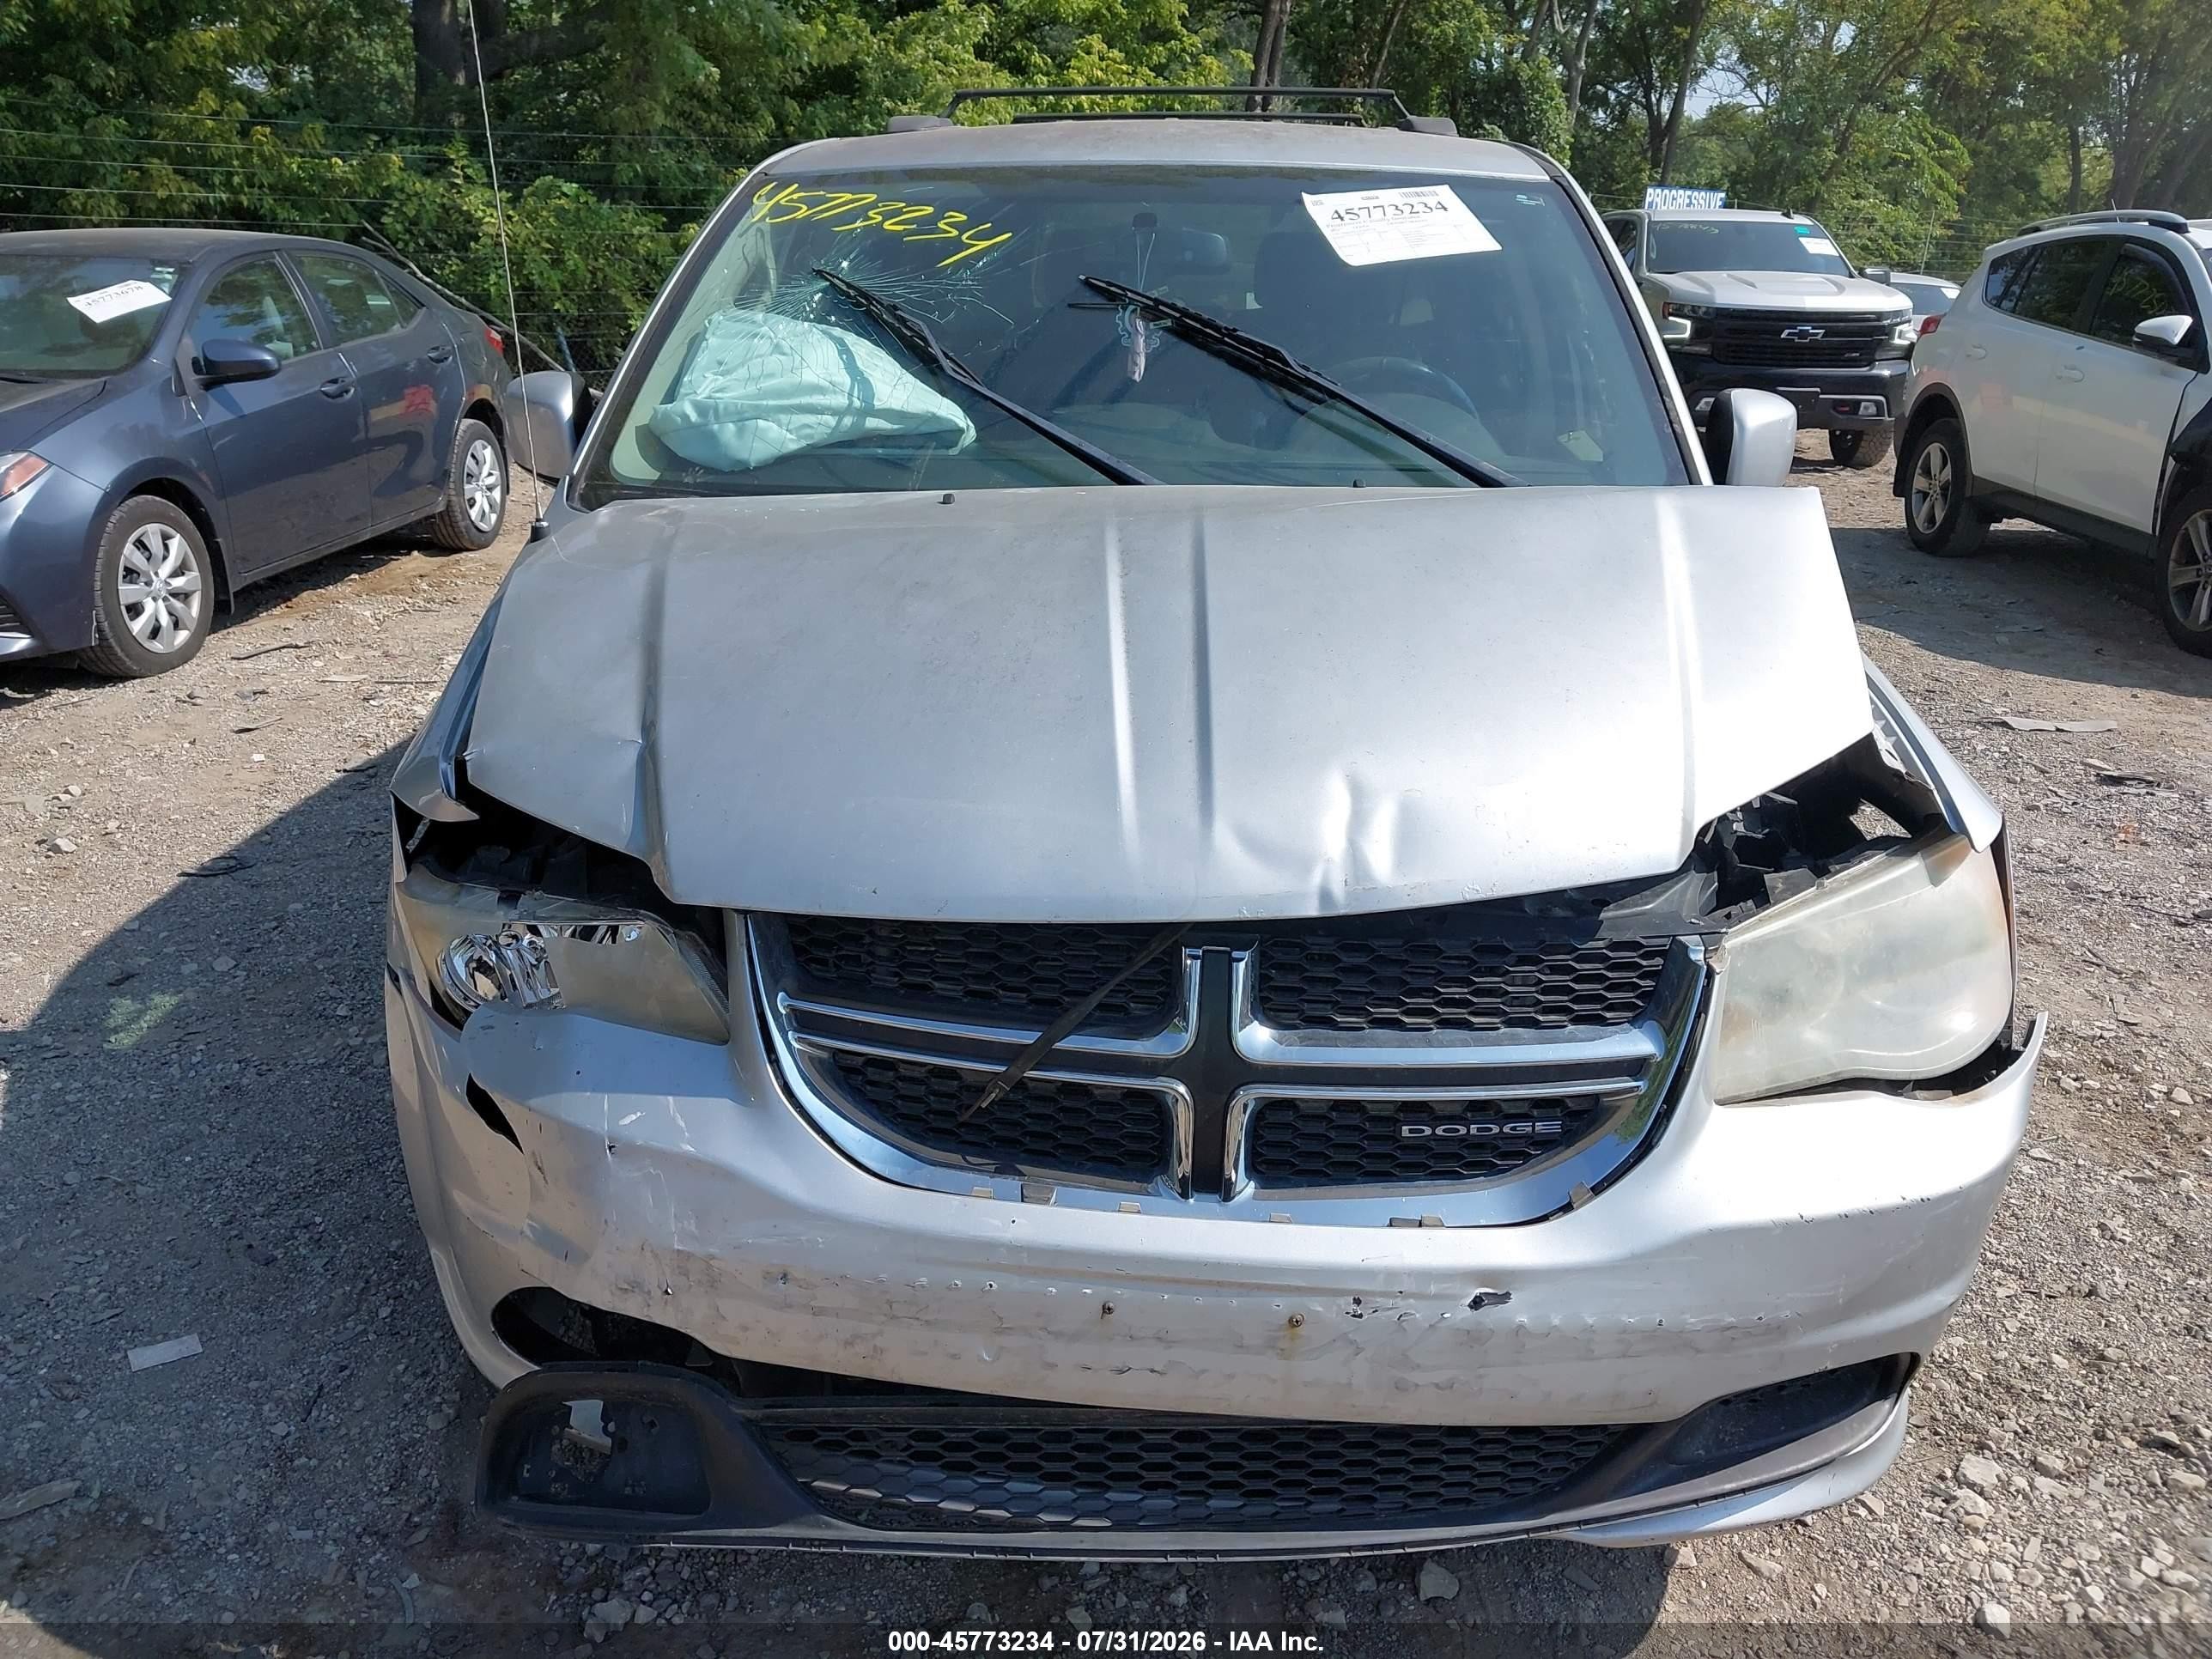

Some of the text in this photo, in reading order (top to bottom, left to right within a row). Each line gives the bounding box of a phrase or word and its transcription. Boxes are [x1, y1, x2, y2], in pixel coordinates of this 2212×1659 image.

[1644, 186, 1727, 210] PROGRESSIVE
[1330, 200, 1449, 222] 45773234
[753, 182, 1013, 267] 45773234
[1401, 1121, 1563, 1137] DODGE
